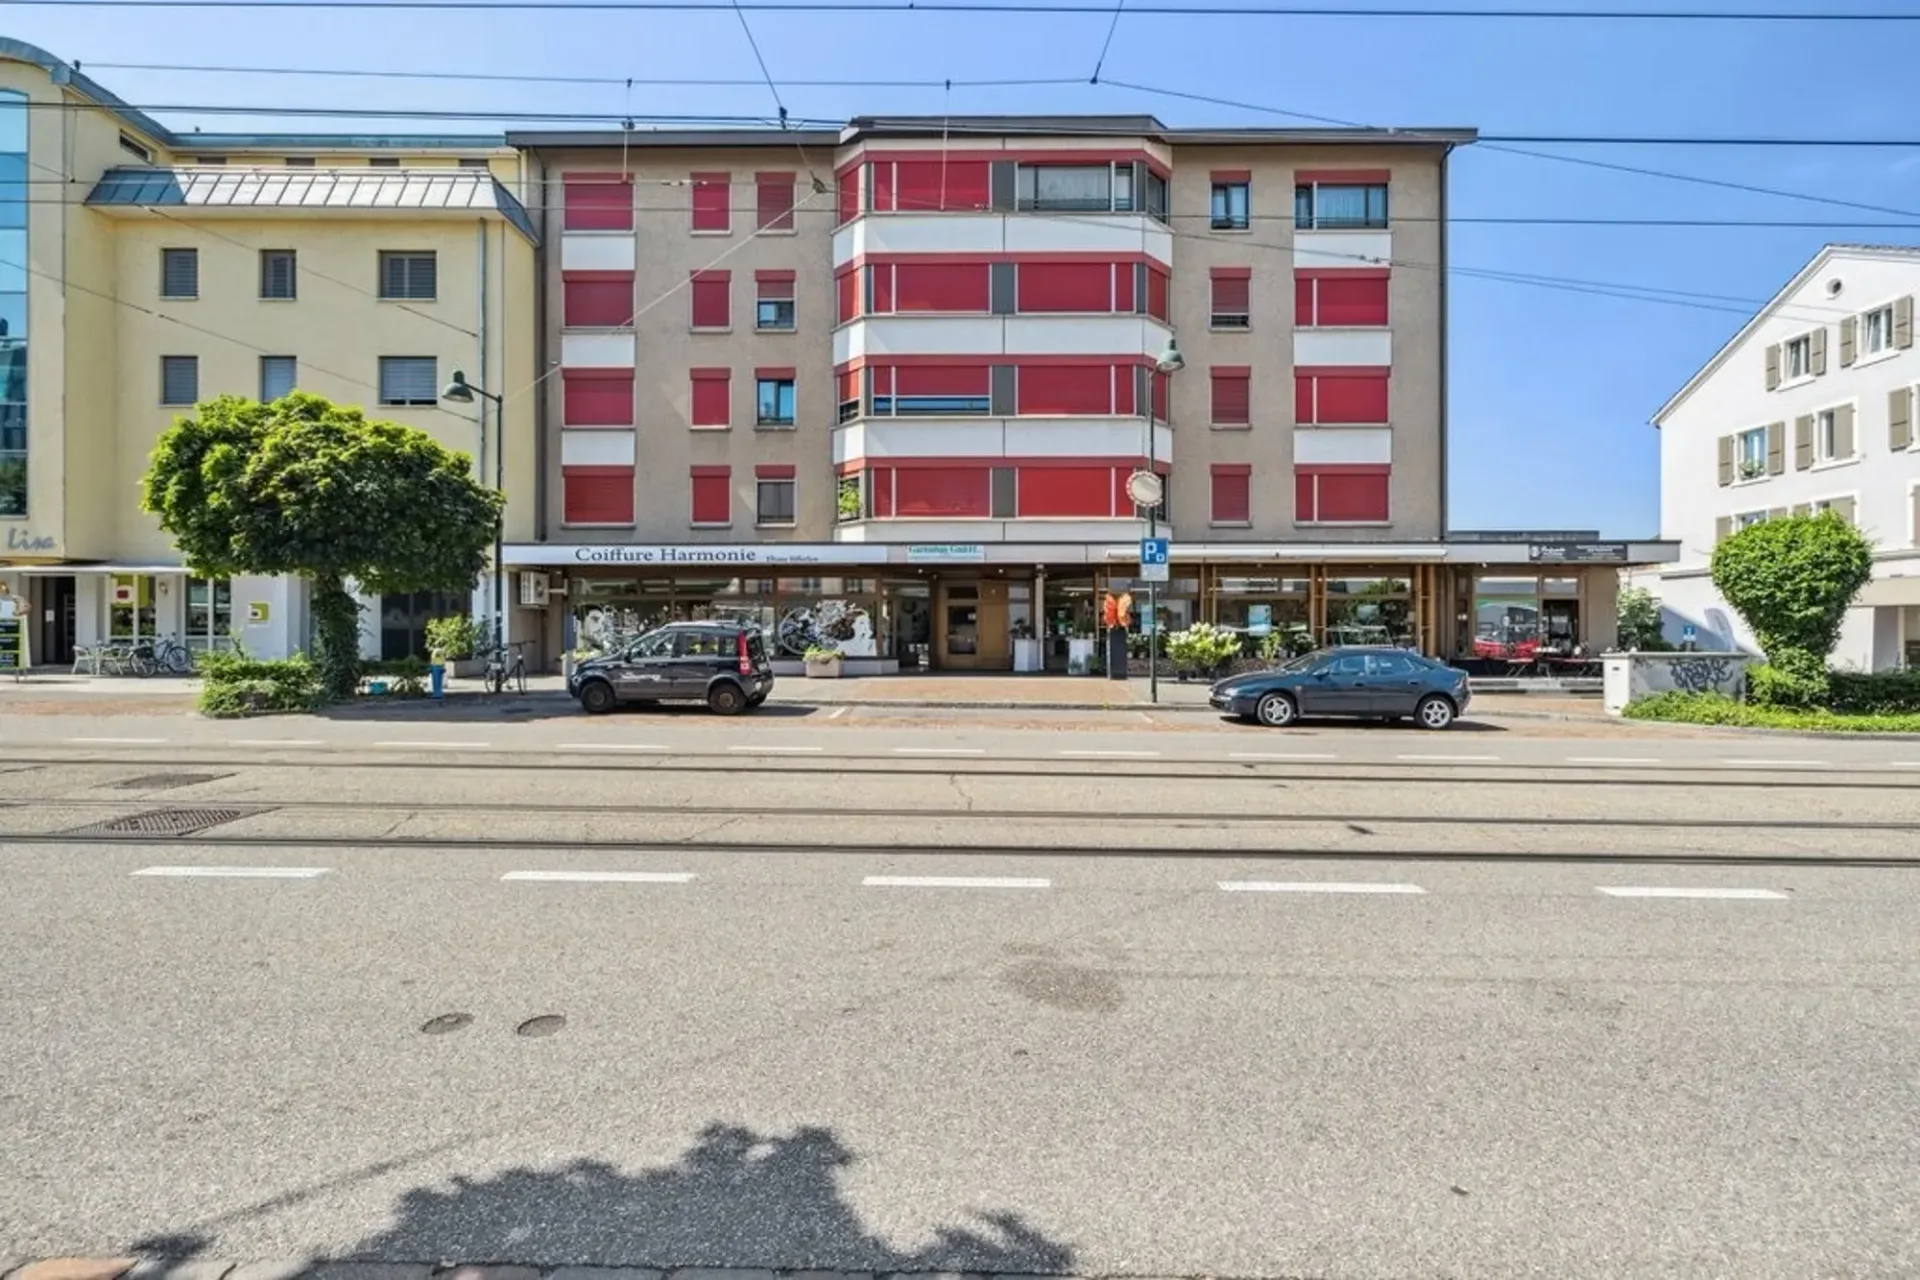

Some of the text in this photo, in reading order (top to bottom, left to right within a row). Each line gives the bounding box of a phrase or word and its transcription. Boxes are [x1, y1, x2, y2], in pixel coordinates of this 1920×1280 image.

[575, 547, 653, 561] Coiffure
[660, 548, 756, 561] Harmonie
[1145, 541, 1157, 561] P
